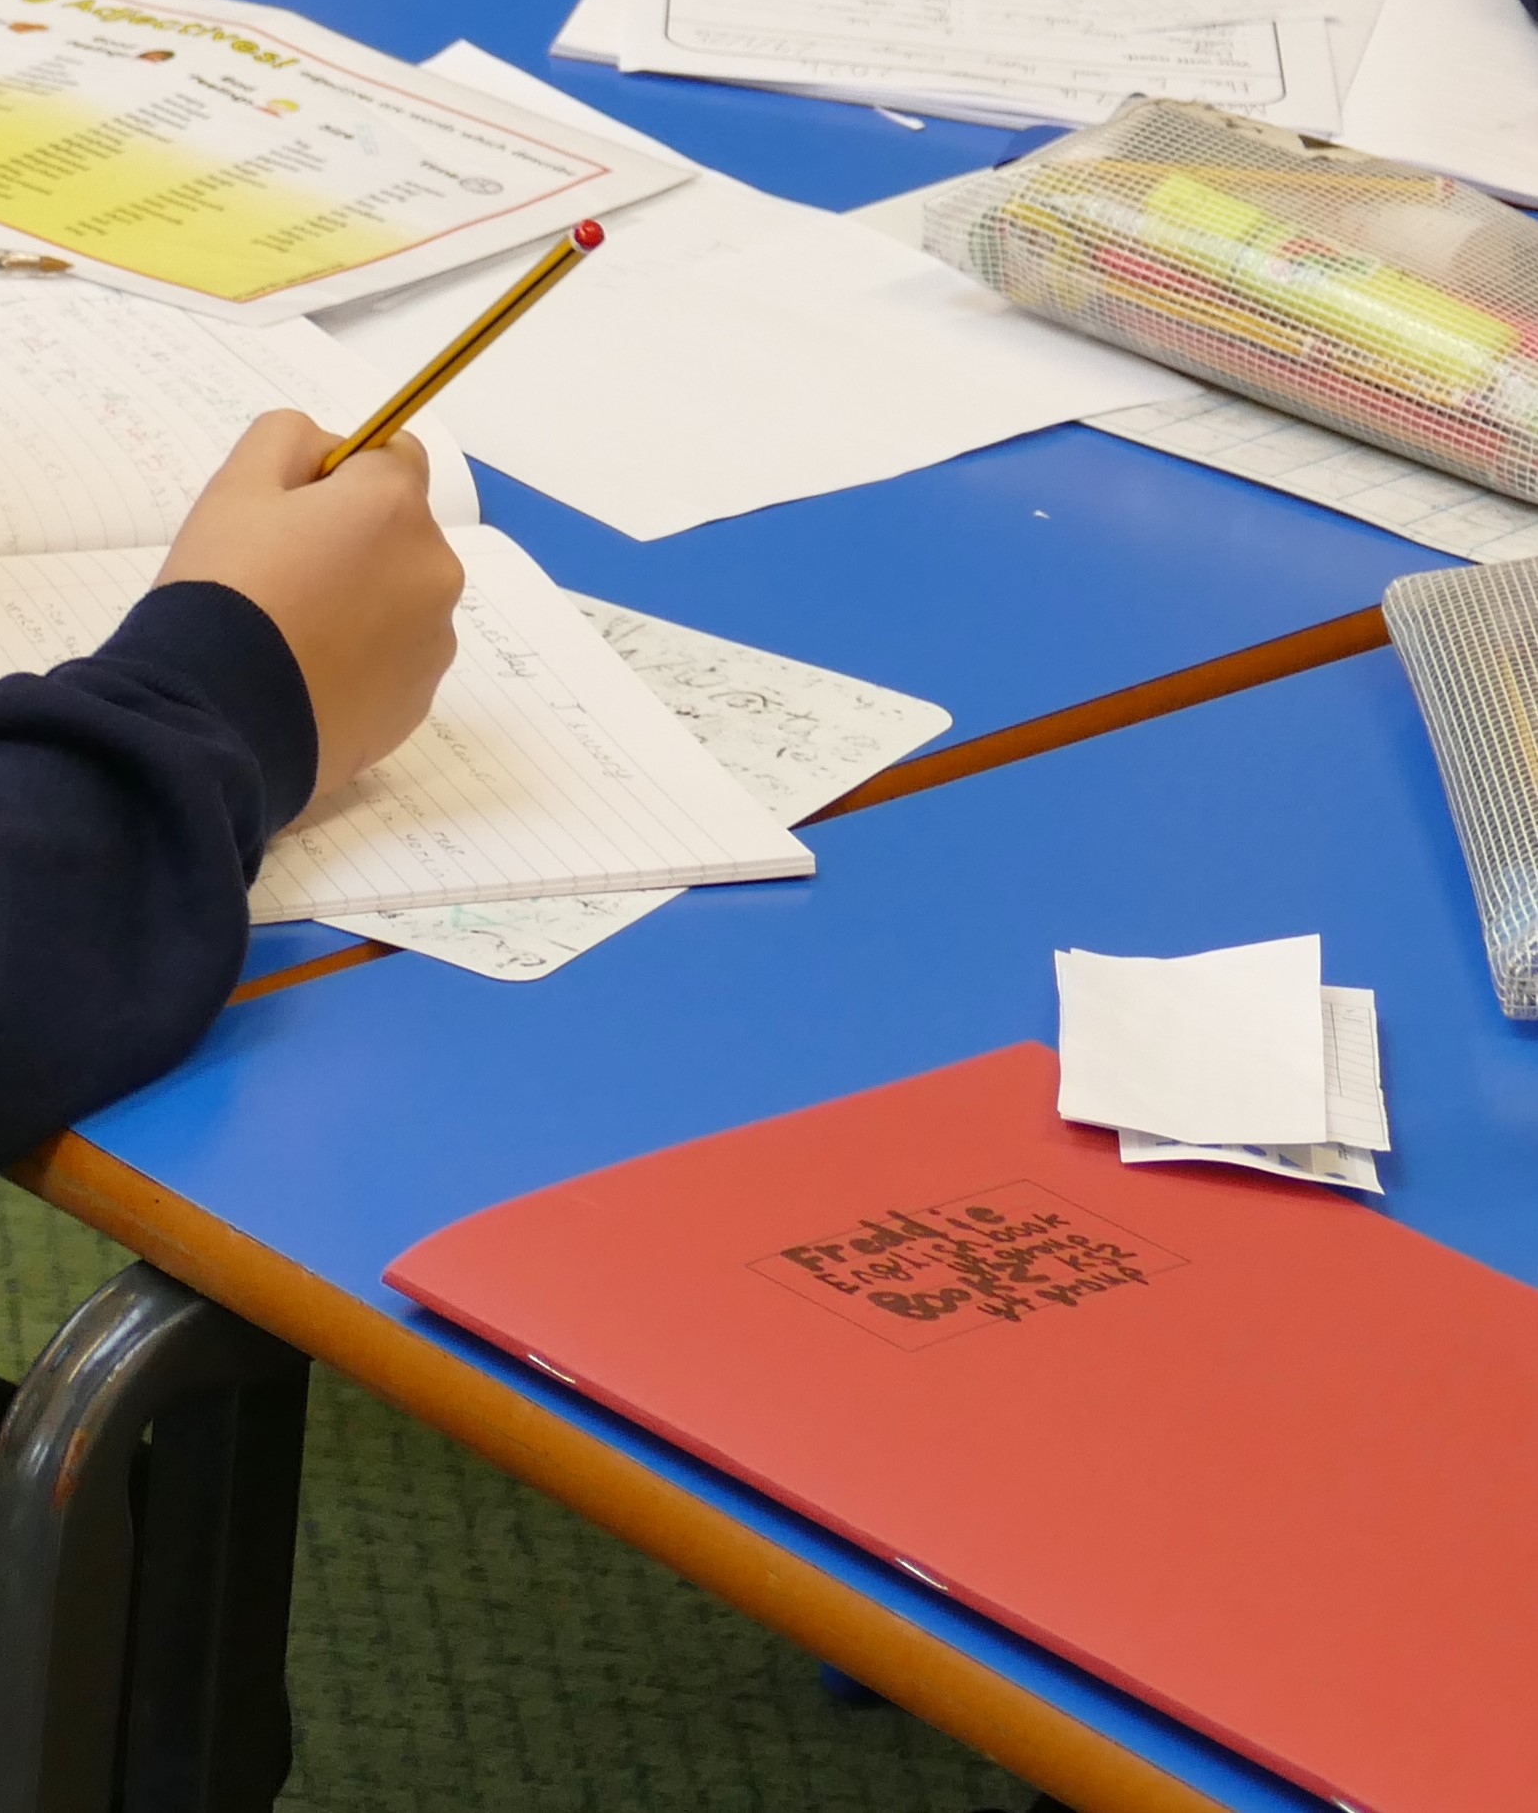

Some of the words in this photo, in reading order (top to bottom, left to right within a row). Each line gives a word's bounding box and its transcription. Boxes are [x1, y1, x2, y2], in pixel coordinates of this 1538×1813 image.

[780, 1206, 1005, 1272] Freddie
[814, 1233, 995, 1295] English
[978, 1212, 1071, 1244] book
